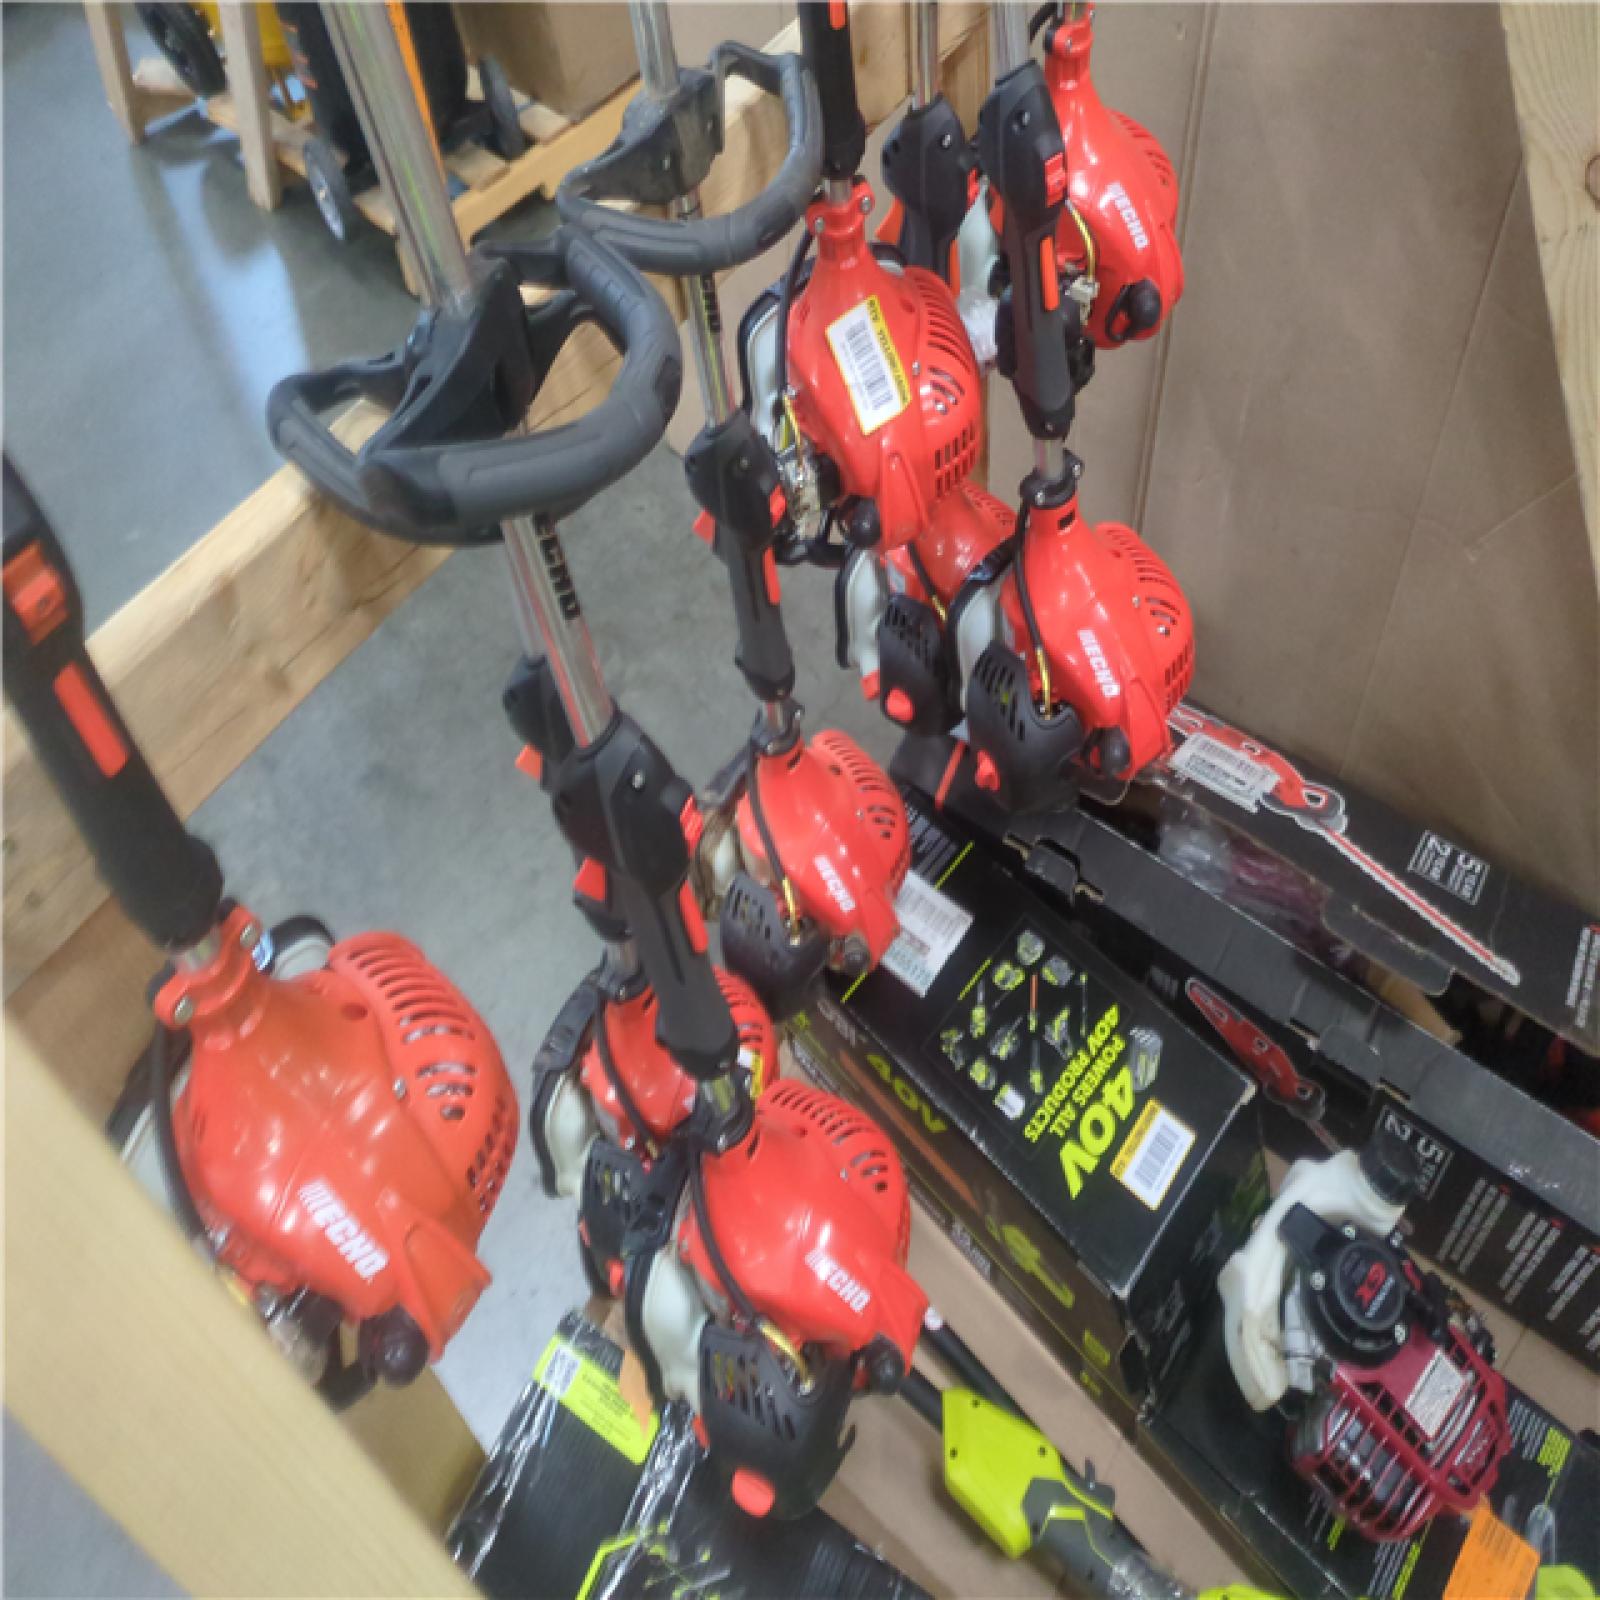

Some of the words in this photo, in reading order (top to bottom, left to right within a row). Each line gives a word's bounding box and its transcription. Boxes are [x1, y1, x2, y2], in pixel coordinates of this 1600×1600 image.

[1107, 183, 1149, 249] ECHO
[1078, 629, 1120, 697] ECHO
[815, 855, 855, 912] ECHO
[1087, 1004, 1119, 1055] 40V
[866, 1053, 948, 1131] 40V
[1024, 1050, 1091, 1142] PRODUCTS
[1072, 1034, 1126, 1106] POWERS
[1049, 1103, 1077, 1137] ALL
[1060, 1067, 1134, 1200] 40V
[299, 1181, 388, 1280] ECHO
[804, 1248, 870, 1313] ECHO
